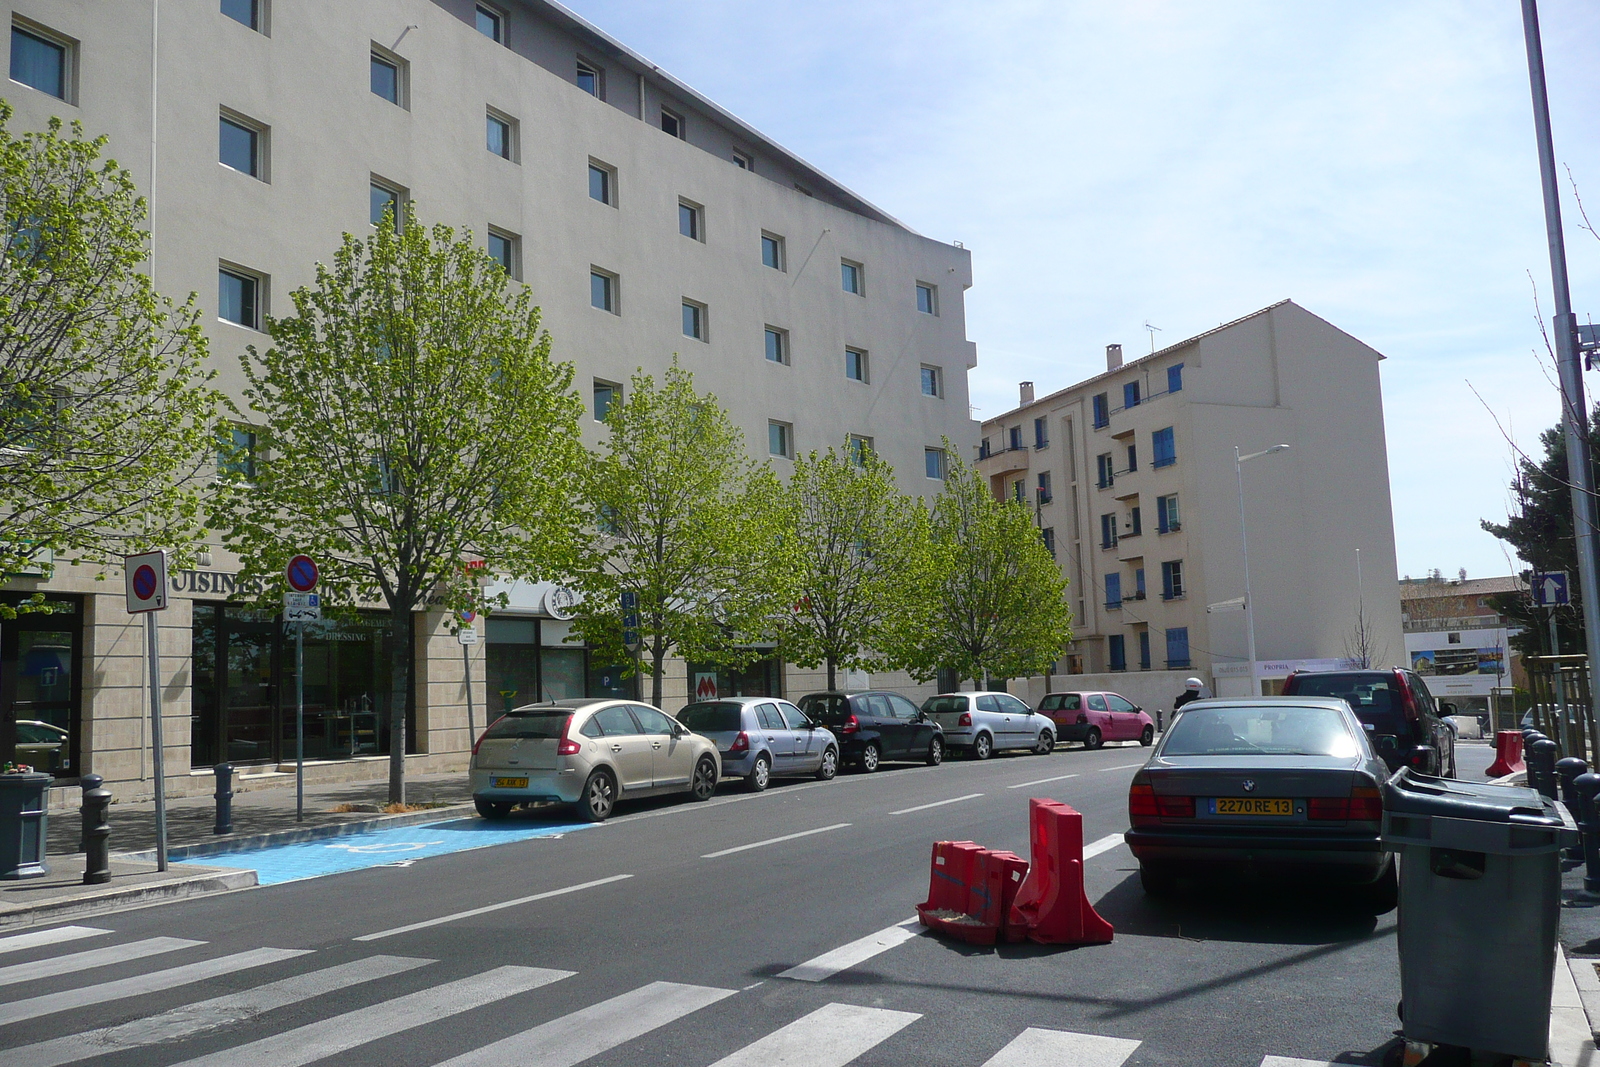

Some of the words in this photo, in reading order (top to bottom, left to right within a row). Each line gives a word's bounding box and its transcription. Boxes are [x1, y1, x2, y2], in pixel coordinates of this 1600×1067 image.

[169, 570, 265, 596] UISINES
[326, 632, 366, 642] DRESSING
[1263, 663, 1289, 671] PROPRIA
[603, 676, 610, 686] P
[1219, 800, 1253, 812] 2270
[1254, 800, 1271, 812] RE
[1274, 801, 1290, 812] 13
